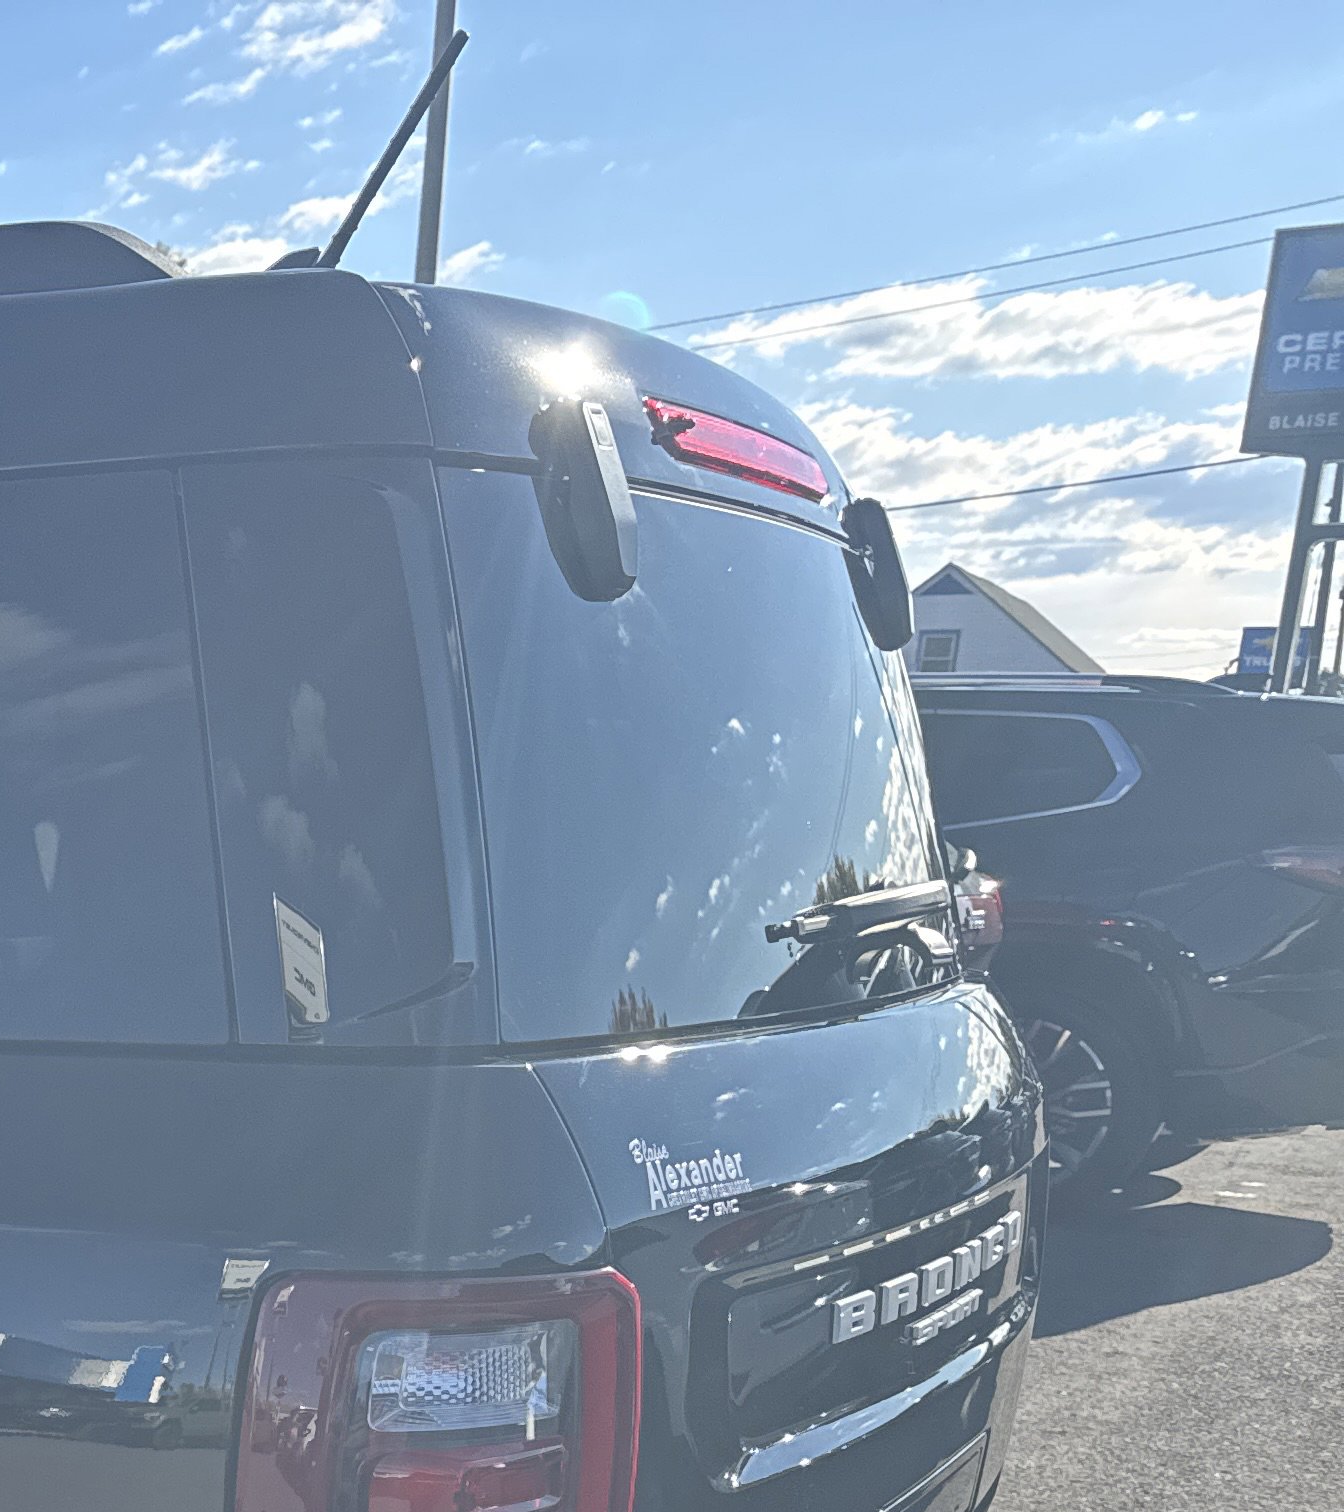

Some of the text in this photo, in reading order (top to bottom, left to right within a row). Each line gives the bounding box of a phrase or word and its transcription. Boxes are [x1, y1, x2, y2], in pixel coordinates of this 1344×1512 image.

[1268, 411, 1341, 431] BLAISE
[628, 1137, 670, 1165] Blaise
[645, 1148, 744, 1211] Alexander
[712, 1198, 741, 1217] GMC
[831, 1210, 1022, 1345] BRONCO
[911, 1288, 983, 1346] SPORT
